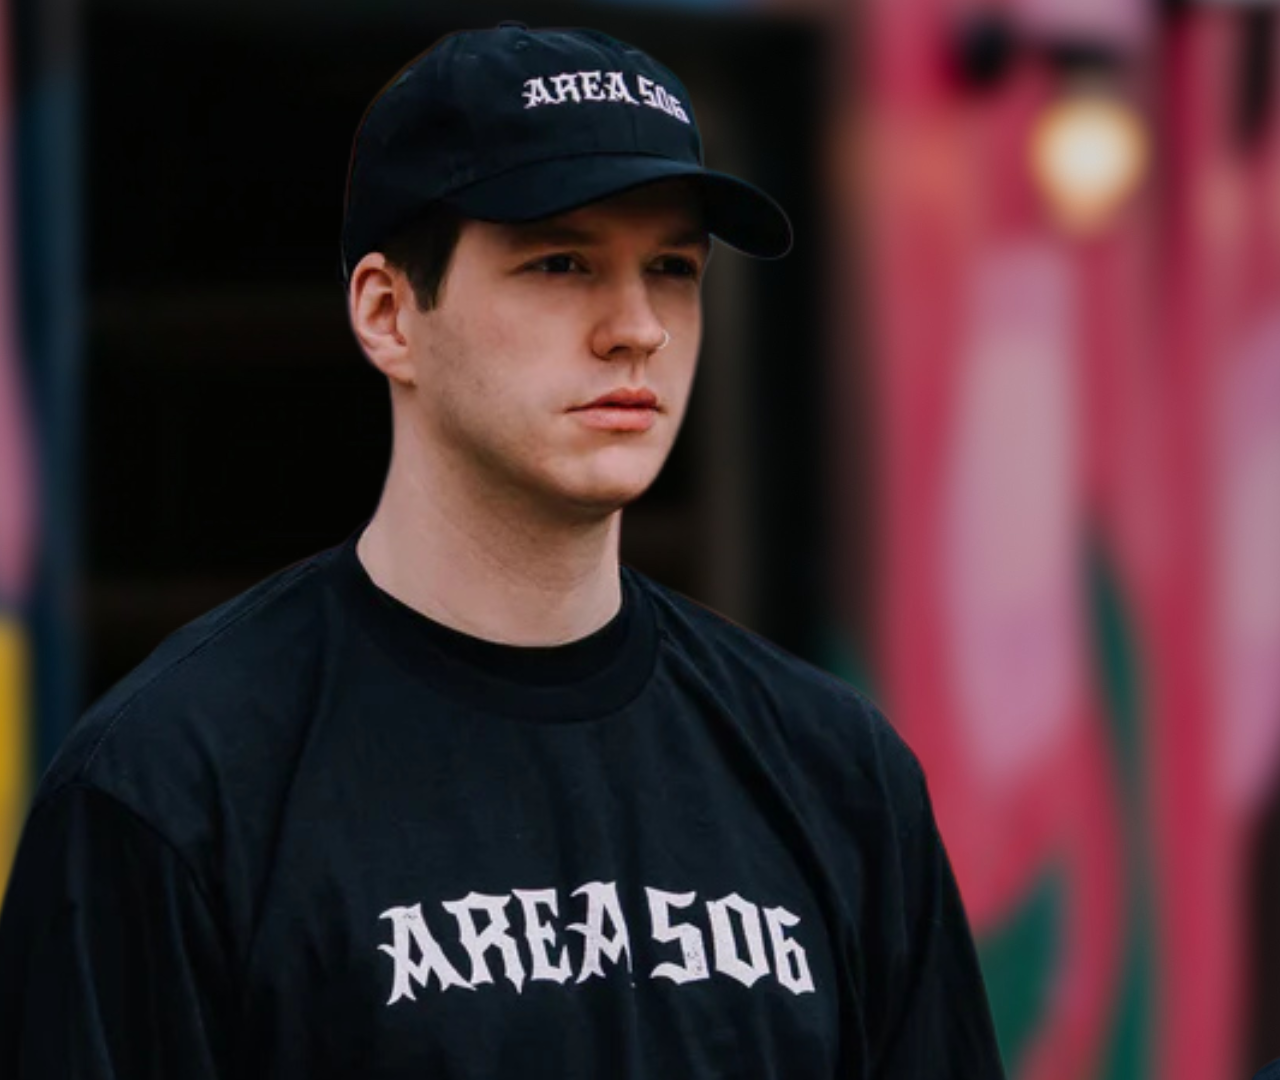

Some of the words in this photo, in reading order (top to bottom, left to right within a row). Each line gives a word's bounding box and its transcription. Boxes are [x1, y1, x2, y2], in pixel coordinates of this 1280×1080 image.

[521, 70, 640, 109] AREA
[636, 74, 690, 124] 506
[377, 881, 636, 1006] AREA
[644, 886, 816, 996] 506
